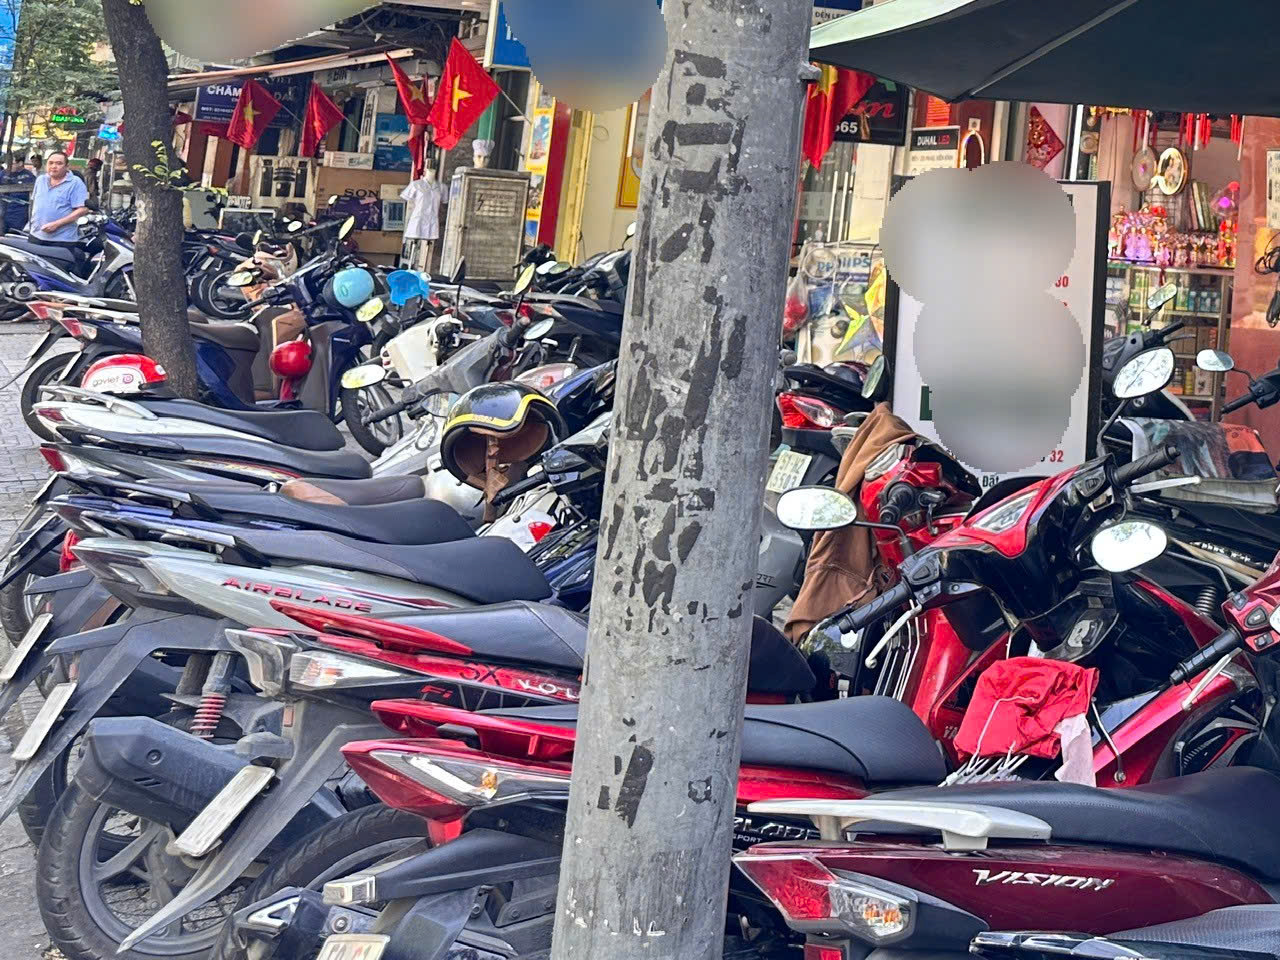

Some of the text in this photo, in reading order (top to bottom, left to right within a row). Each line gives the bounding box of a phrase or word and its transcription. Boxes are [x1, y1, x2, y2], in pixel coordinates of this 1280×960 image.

[835, 121, 858, 134] 65
[917, 135, 938, 146] DUHAL
[1050, 450, 1064, 463] 32
[971, 868, 1116, 891] VISION
